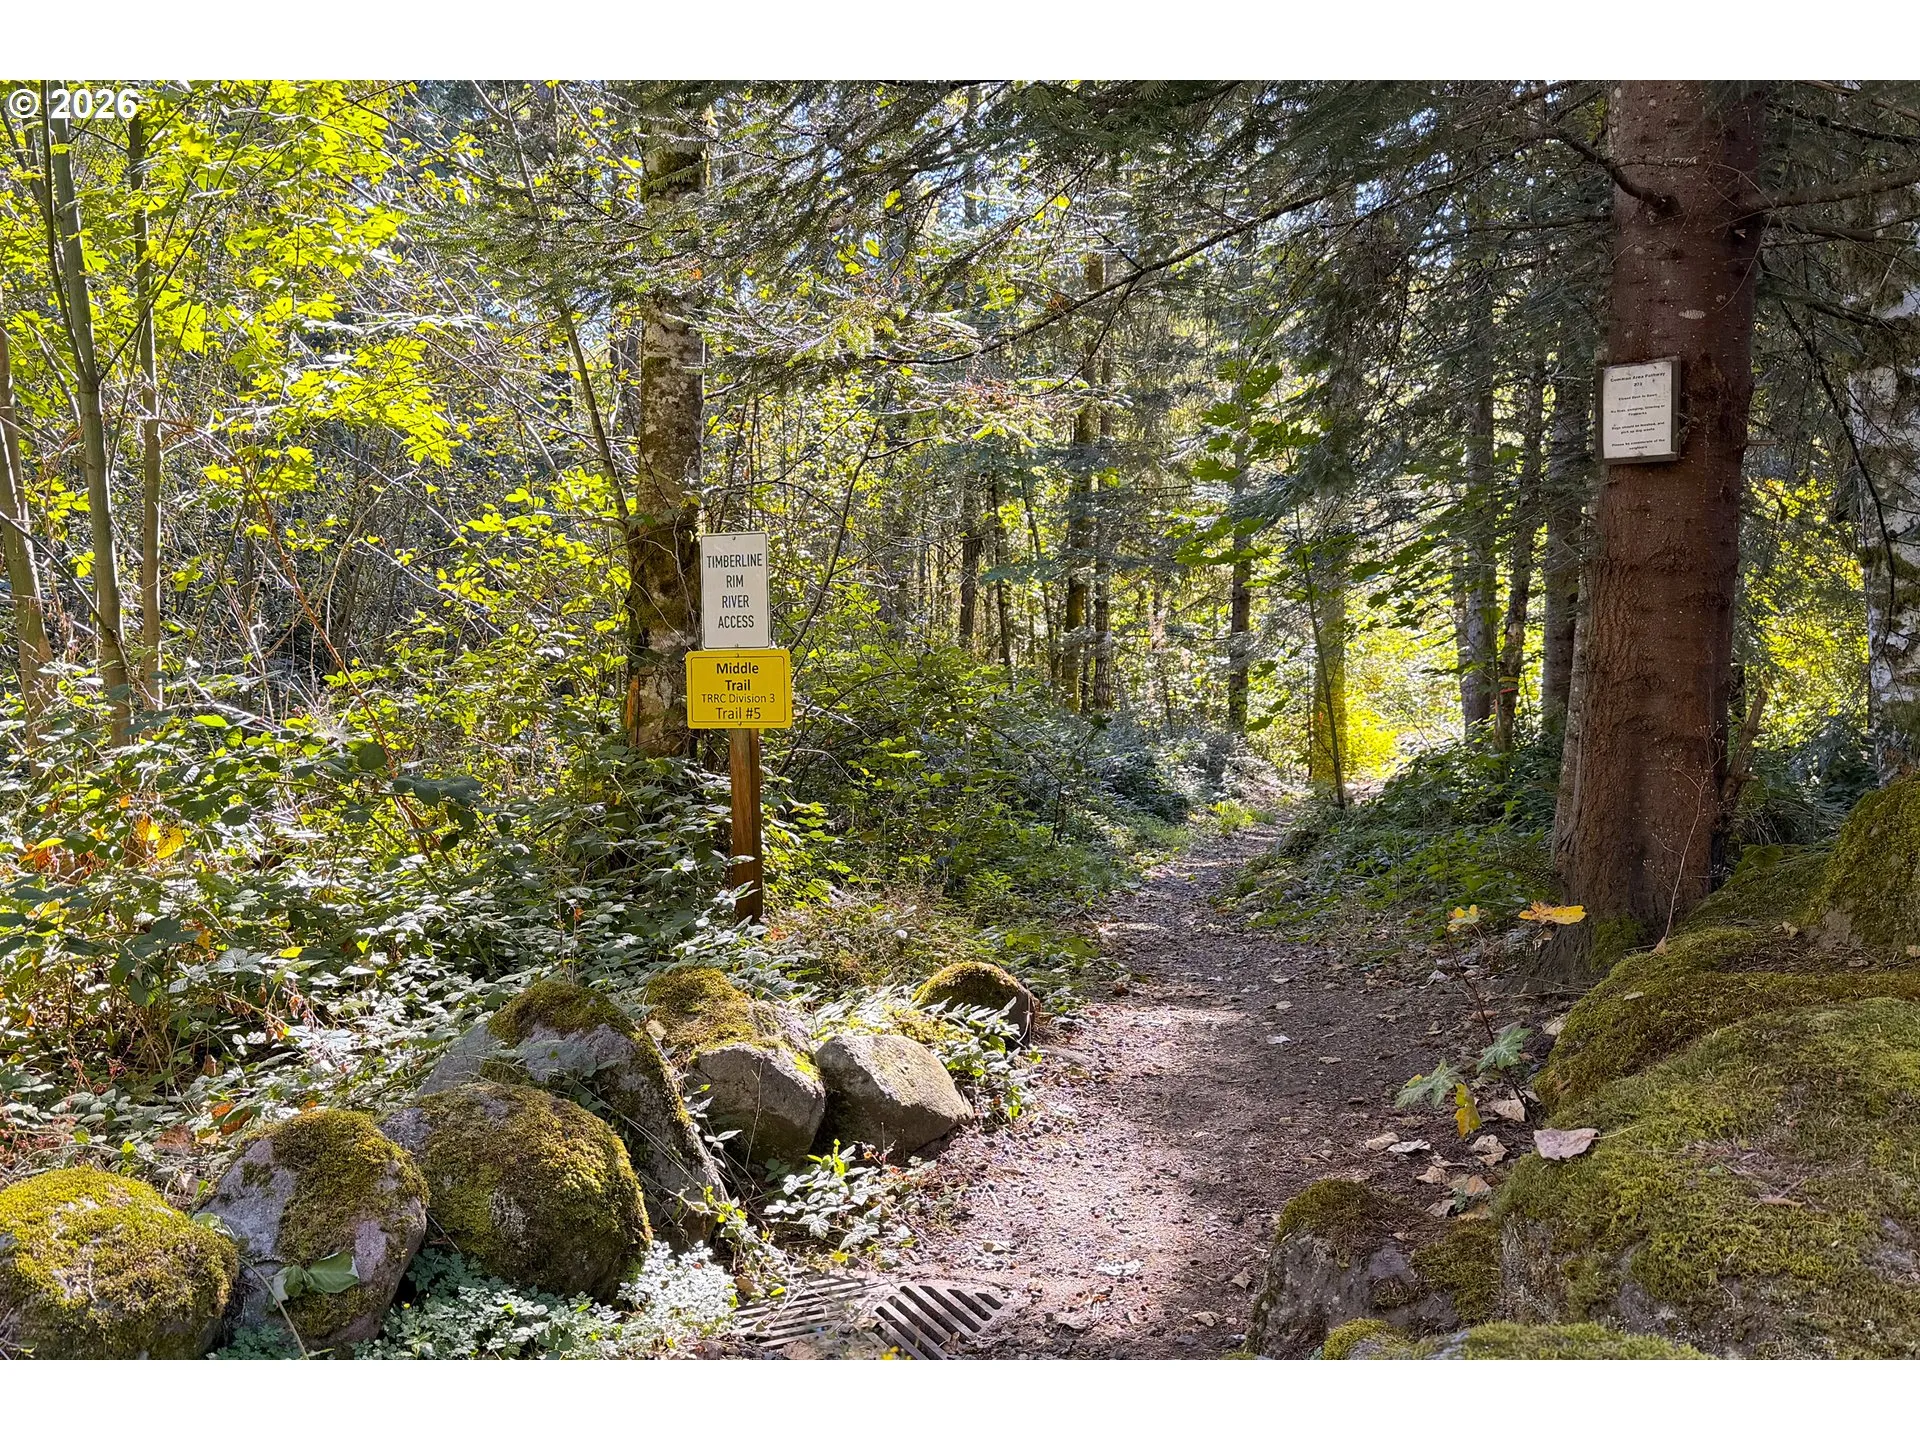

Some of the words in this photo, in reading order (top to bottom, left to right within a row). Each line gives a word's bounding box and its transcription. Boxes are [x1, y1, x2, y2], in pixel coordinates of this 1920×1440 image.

[707, 554, 762, 568] TIMBERLINE
[726, 574, 744, 588] RIM
[722, 594, 749, 609] RIVER
[718, 615, 754, 629] ACCESS
[716, 662, 759, 674] Middle
[725, 679, 751, 691] Trail
[701, 693, 726, 703] TRRC
[729, 693, 767, 703] Division
[770, 693, 775, 703] 3
[716, 707, 742, 720] Trail
[746, 707, 761, 720] #5
